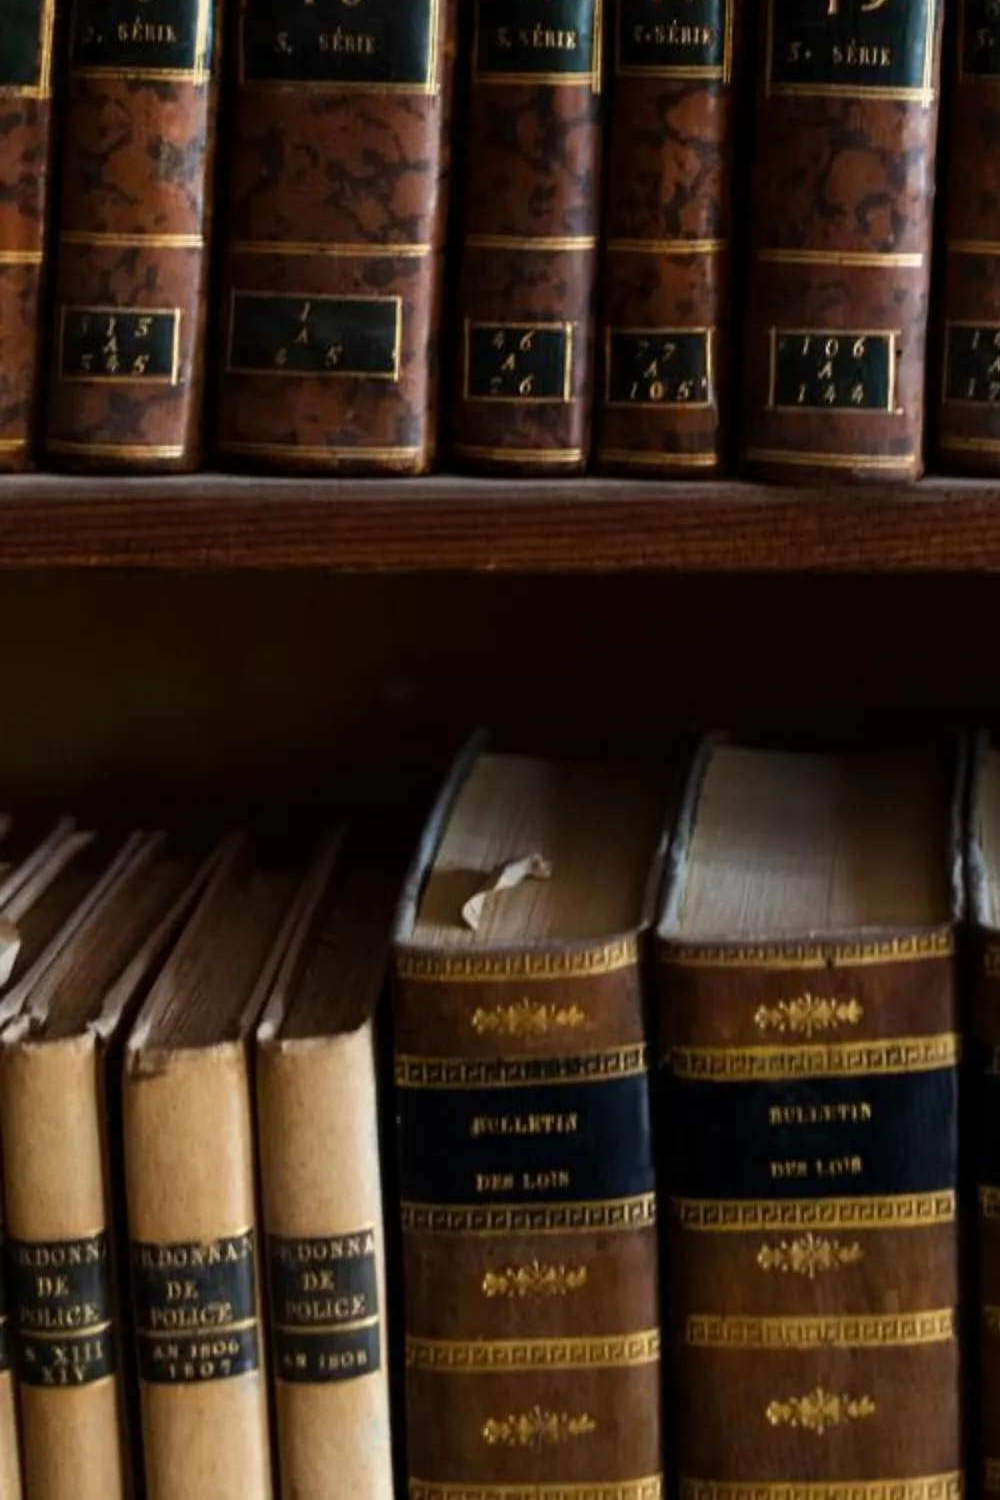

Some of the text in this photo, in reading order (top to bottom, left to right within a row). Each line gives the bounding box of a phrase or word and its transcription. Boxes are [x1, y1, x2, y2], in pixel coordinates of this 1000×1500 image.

[802, 336, 864, 358] 106
[37, 1276, 69, 1297] DE
[303, 1269, 335, 1292] DE
[150, 1302, 234, 1329] POLICE
[285, 1293, 365, 1321] POLICE
